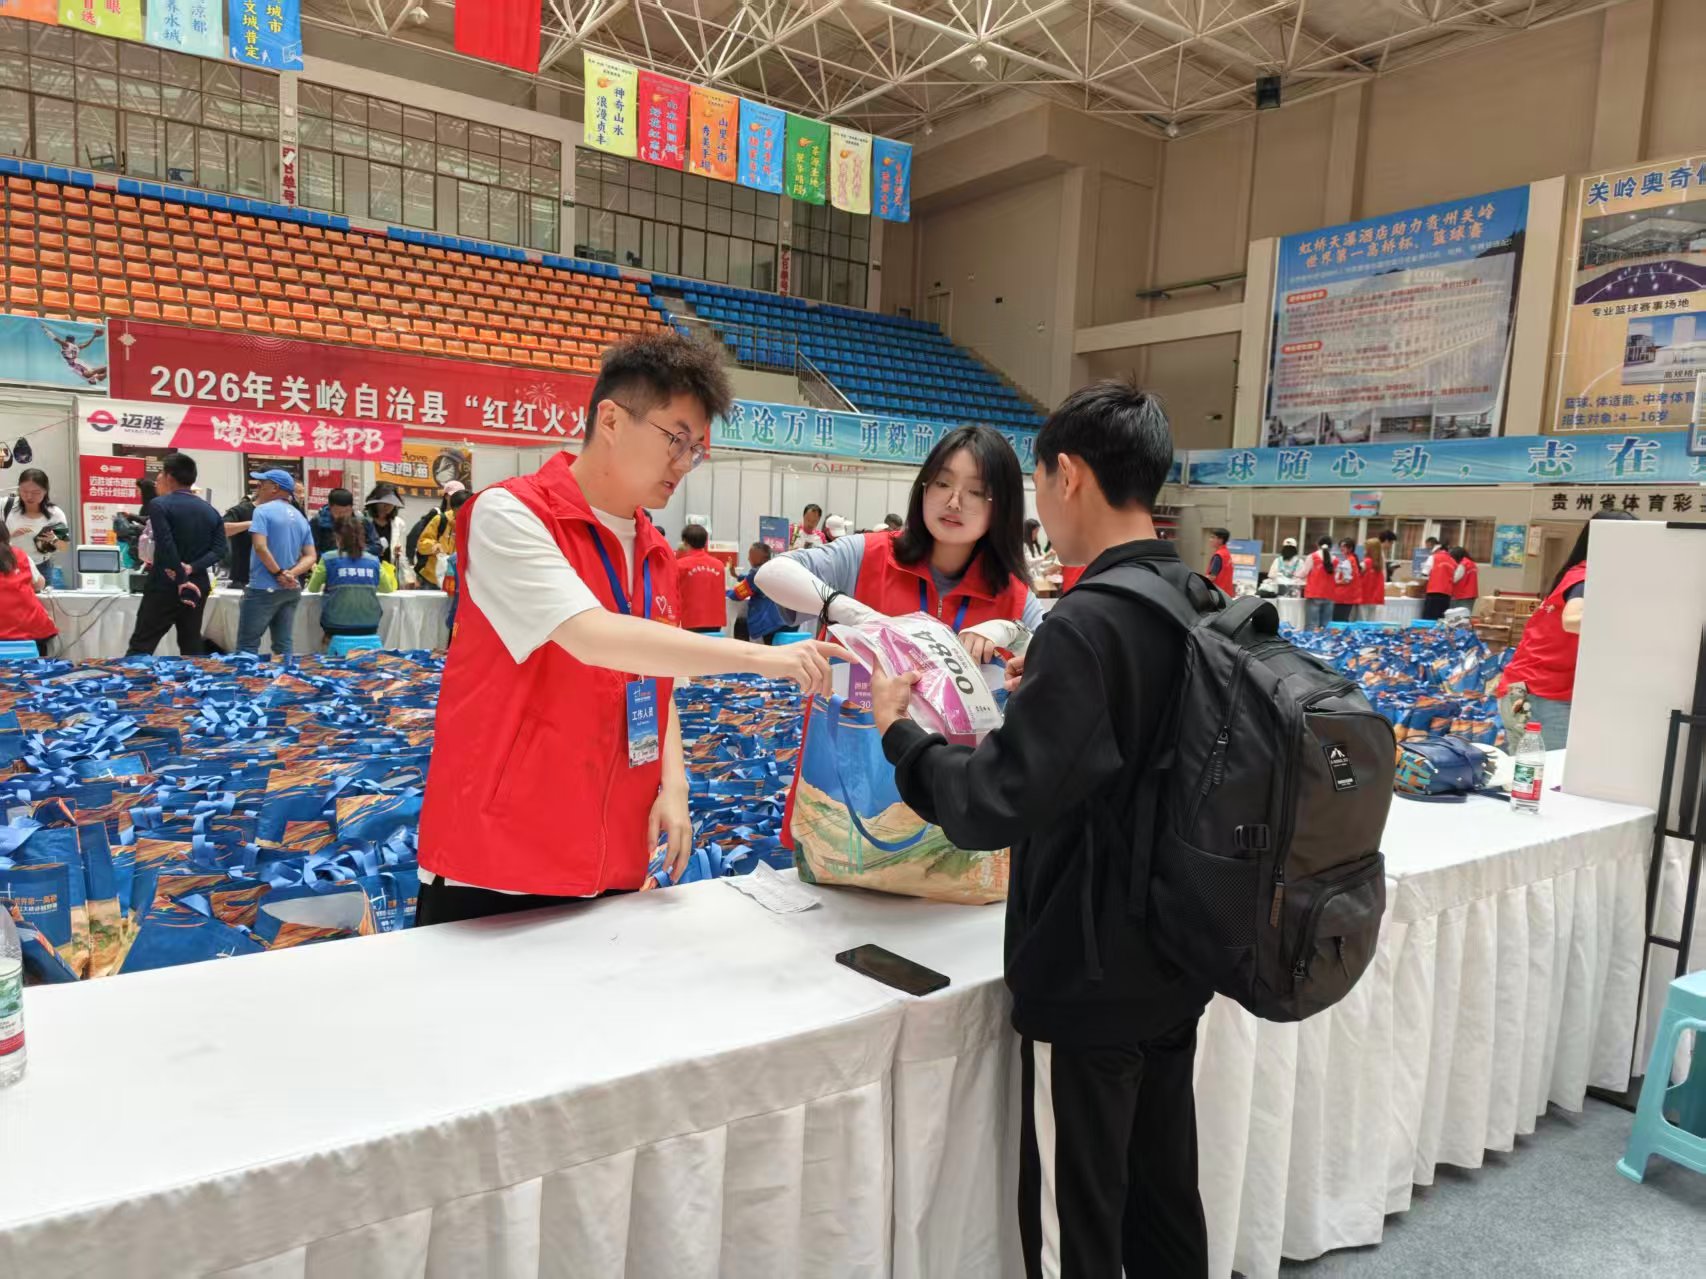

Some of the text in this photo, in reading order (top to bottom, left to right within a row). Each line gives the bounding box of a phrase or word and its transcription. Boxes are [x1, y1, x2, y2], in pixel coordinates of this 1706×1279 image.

[613, 87, 626, 136] 神奇山水
[1592, 298, 1690, 317] 专业篮球赛事场地
[121, 413, 165, 430] 迈胜
[1552, 491, 1706, 512] 贵州省体育彩
[911, 631, 974, 694] 4800
[632, 706, 654, 720] 工作人员
